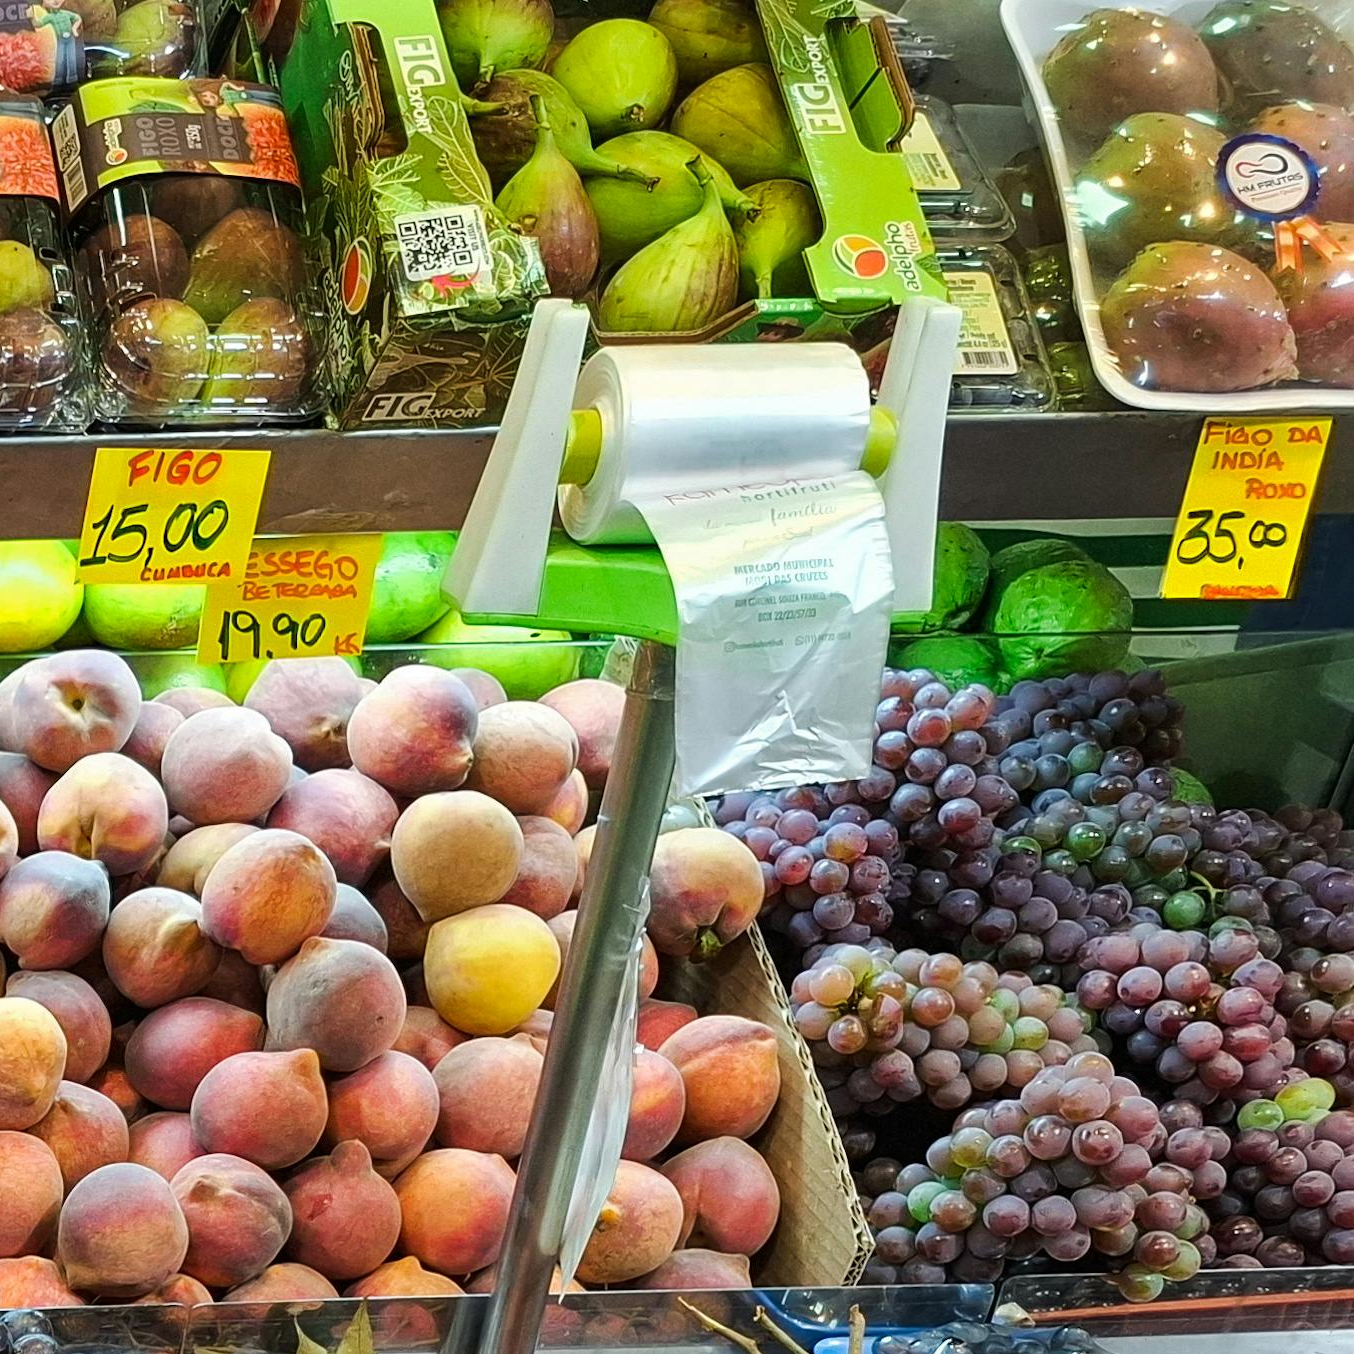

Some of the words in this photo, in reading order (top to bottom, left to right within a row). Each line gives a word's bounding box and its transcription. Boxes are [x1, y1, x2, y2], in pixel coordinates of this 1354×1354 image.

[397, 37, 442, 85] FIG
[803, 36, 830, 85] EXPORT
[407, 86, 433, 134] EXPORT
[802, 85, 842, 133] FIG
[135, 117, 160, 157] FIGO
[155, 116, 182, 156] ROXO
[1236, 183, 1256, 195] HM
[1256, 172, 1304, 191] FRUTAS
[904, 222, 920, 252] frutas
[887, 222, 920, 291] adelpho
[364, 395, 433, 419] FIG
[426, 407, 486, 419] EXPORT
[1287, 425, 1323, 444] DA
[127, 450, 223, 487] FIGO
[740, 481, 837, 503] hortifruti
[1245, 477, 1306, 500] ROXO
[79, 499, 230, 568] 15,00
[1177, 509, 1287, 570] 35,00
[140, 561, 232, 582] CUMBUCA
[245, 549, 359, 581] ESSEGO
[733, 561, 781, 575] MERCADO
[783, 558, 835, 570] MUNICIPAL
[774, 574, 792, 585] DAS
[794, 571, 829, 582] CRUZES
